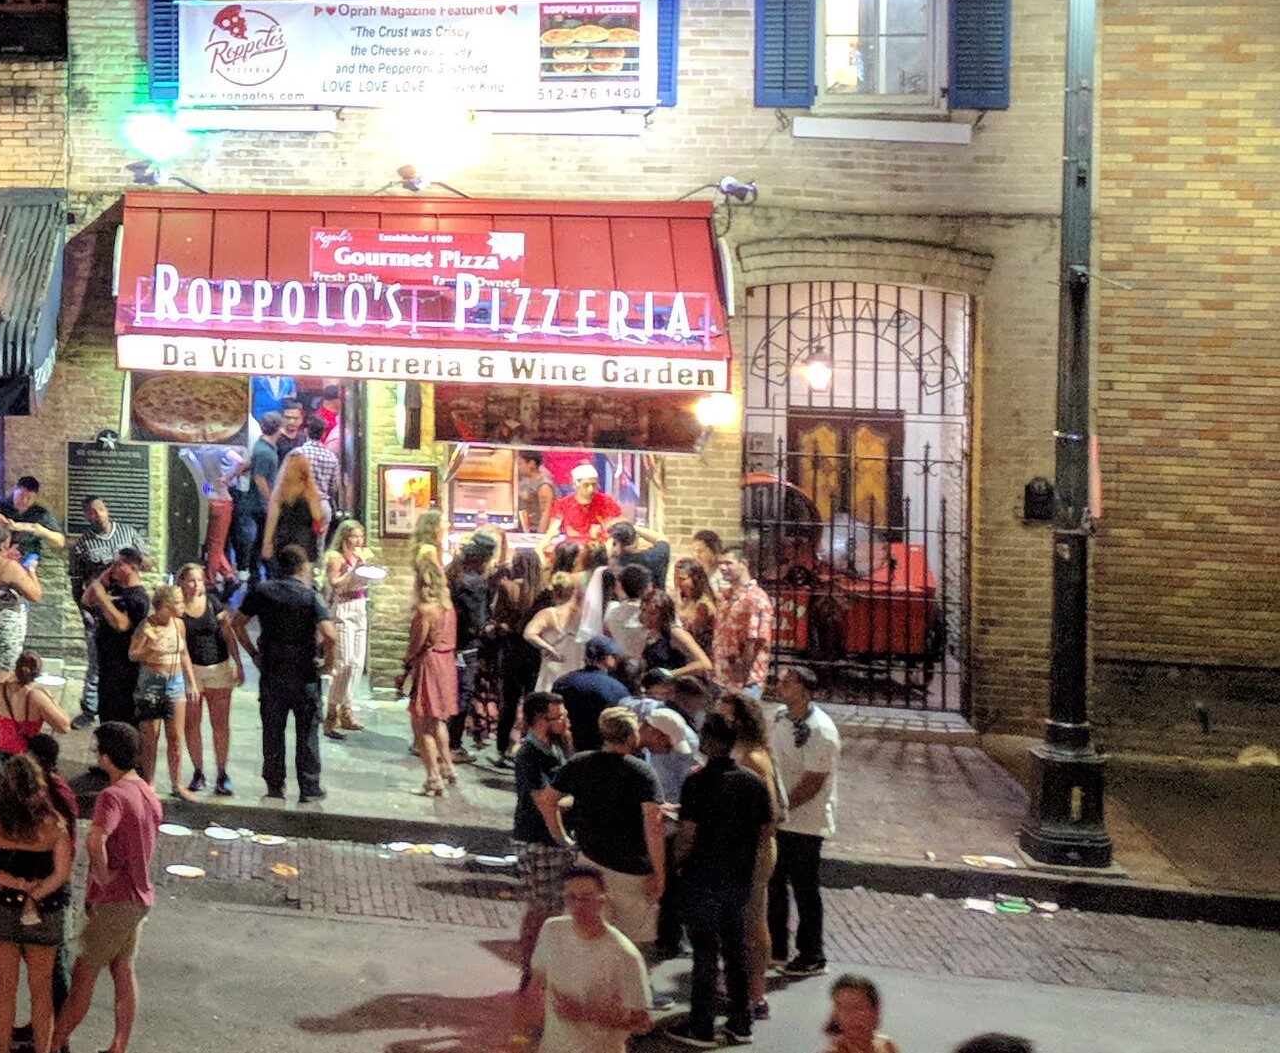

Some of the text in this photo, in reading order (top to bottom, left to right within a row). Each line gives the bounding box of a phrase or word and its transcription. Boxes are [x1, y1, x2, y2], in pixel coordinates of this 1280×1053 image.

[338, 4, 493, 19] Oprah Magazine Featured
[378, 26, 408, 38] Crust
[411, 29, 432, 38] was
[351, 45, 367, 56] the
[371, 44, 410, 56] Cheese
[336, 63, 356, 74] and
[358, 63, 375, 74] the
[322, 81, 352, 92] LOVE
[359, 81, 388, 92] LOVE
[396, 81, 425, 92] LOVE
[378, 233, 429, 243] Established
[333, 246, 500, 270] Gourmet Pizza
[313, 272, 378, 284] Fresh Daily
[477, 277, 520, 288] Owned
[154, 263, 692, 339] ROPPOLO'S PIZZERIA
[162, 344, 197, 367] Da
[212, 345, 312, 371] Vincis
[347, 350, 462, 377] Birreria
[478, 356, 495, 378] &
[510, 357, 586, 381] Wine
[602, 360, 715, 386] Garden
